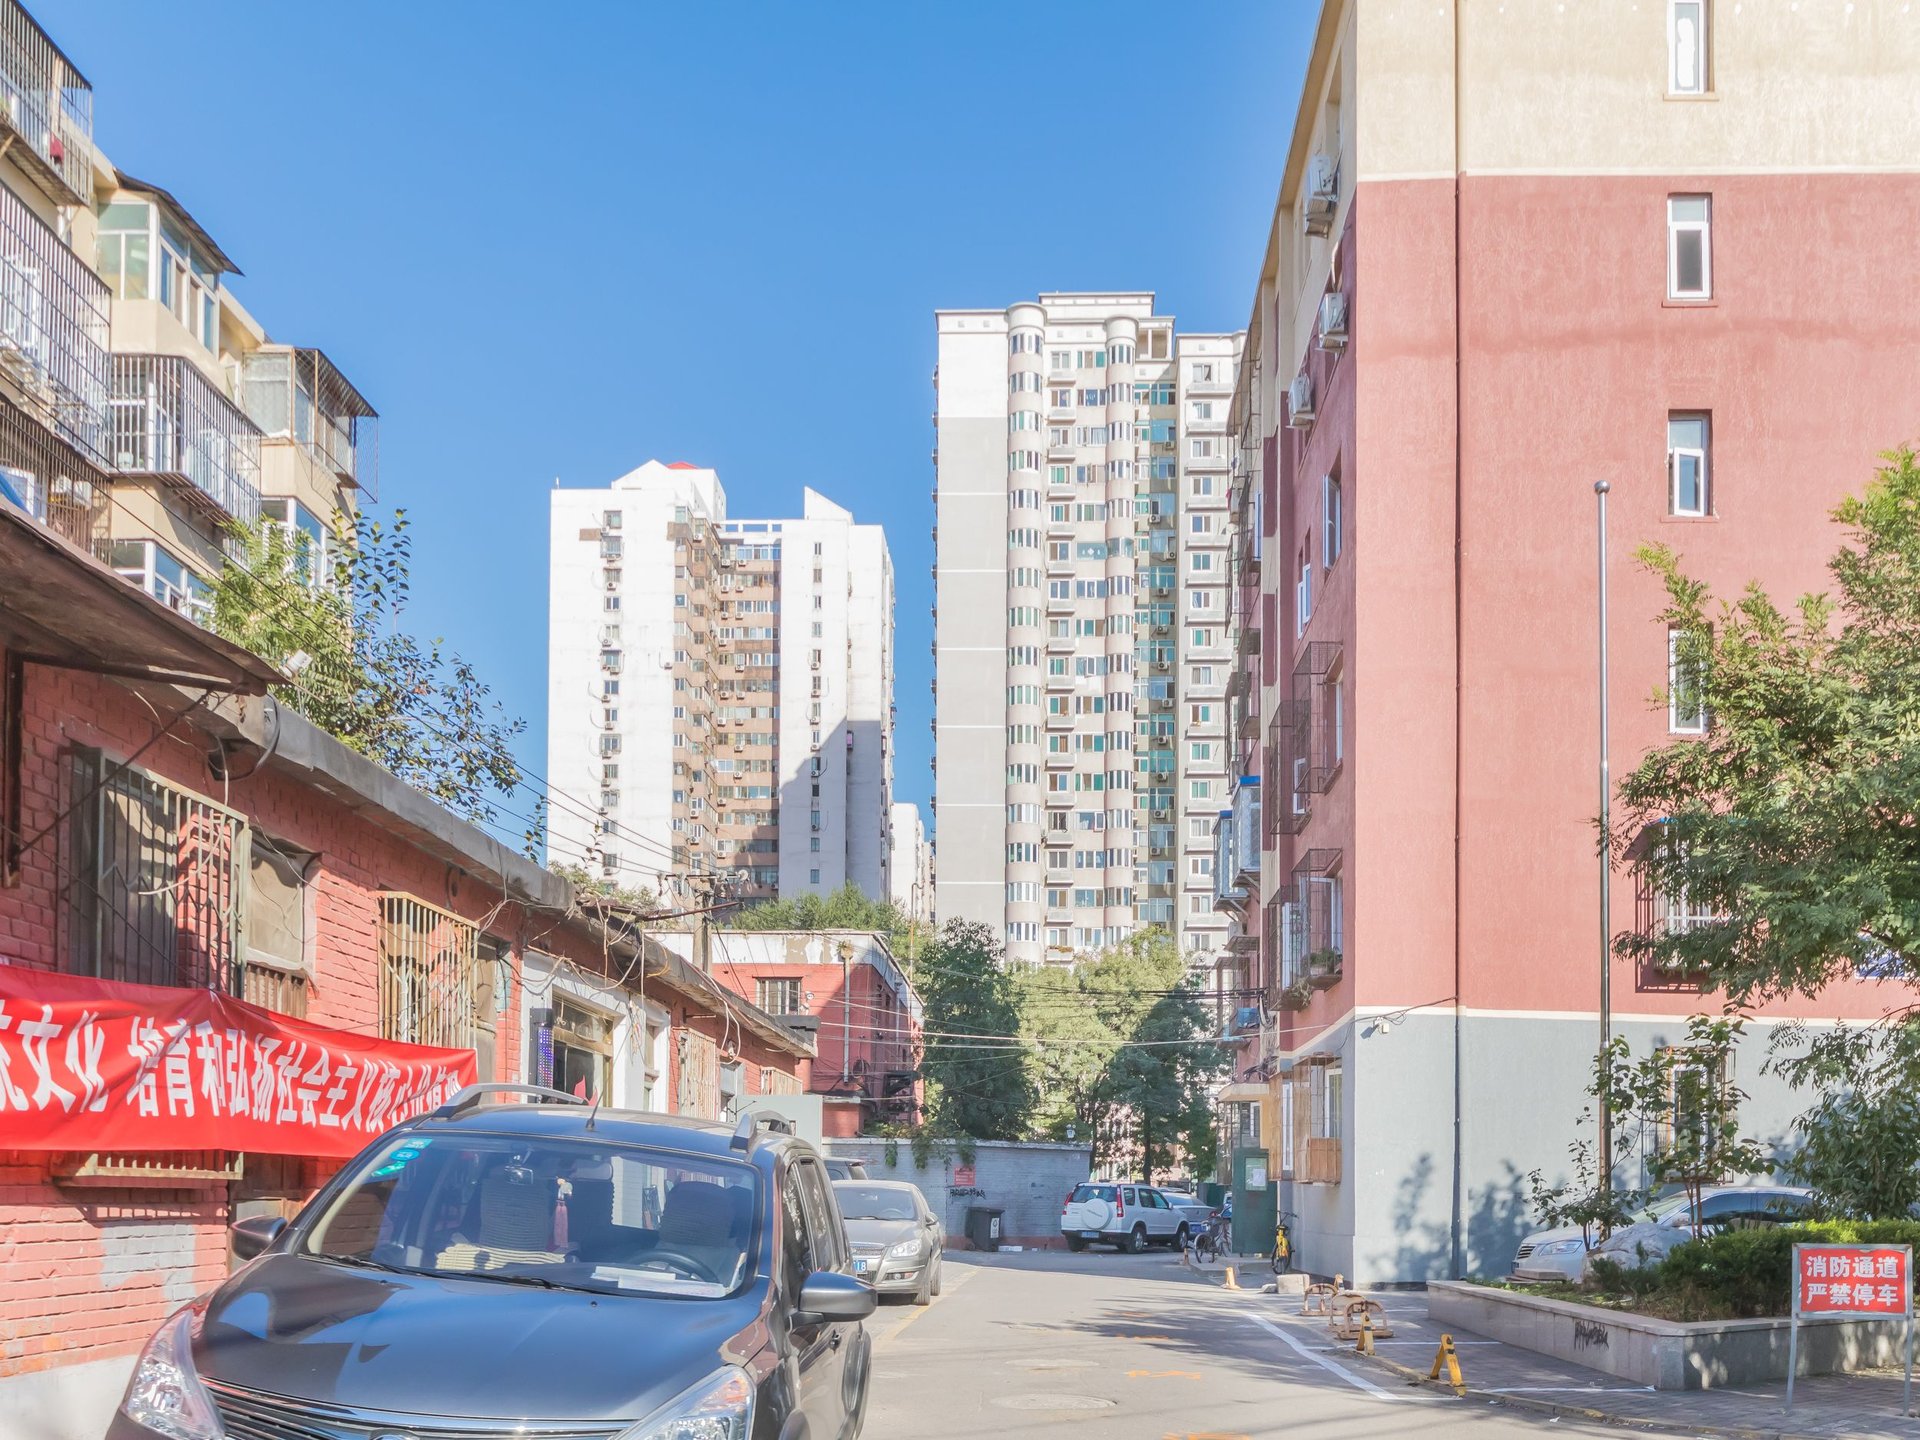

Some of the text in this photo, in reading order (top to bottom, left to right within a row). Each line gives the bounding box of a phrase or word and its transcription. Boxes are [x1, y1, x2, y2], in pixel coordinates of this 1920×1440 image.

[1806, 1255, 1899, 1279] 消防通道
[1806, 1283, 1899, 1307] 严禁停车
